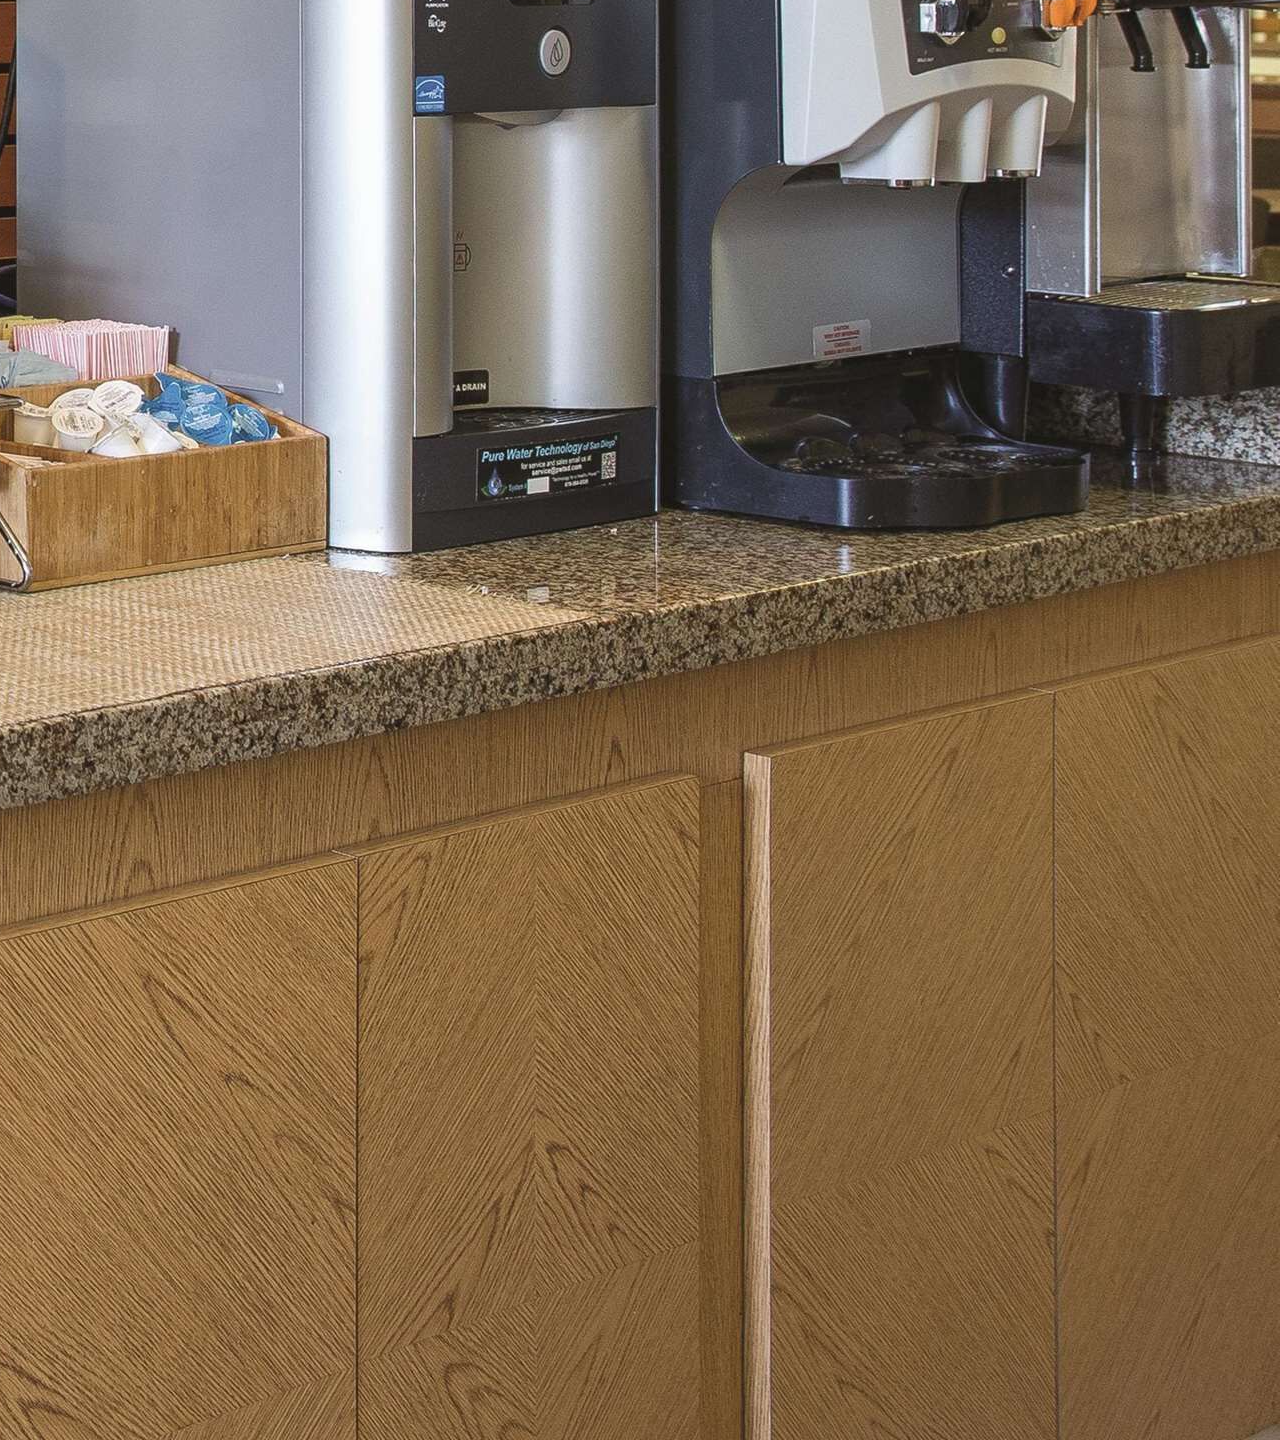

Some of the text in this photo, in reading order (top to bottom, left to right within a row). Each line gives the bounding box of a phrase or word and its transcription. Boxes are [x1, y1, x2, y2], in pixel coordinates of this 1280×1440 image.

[461, 383, 487, 391] DRAIN
[481, 450, 504, 463] Pure
[506, 447, 534, 461] Water
[535, 441, 583, 456] Technology
[589, 442, 600, 450] San
[601, 439, 616, 448] Diego
[528, 461, 546, 469] service
